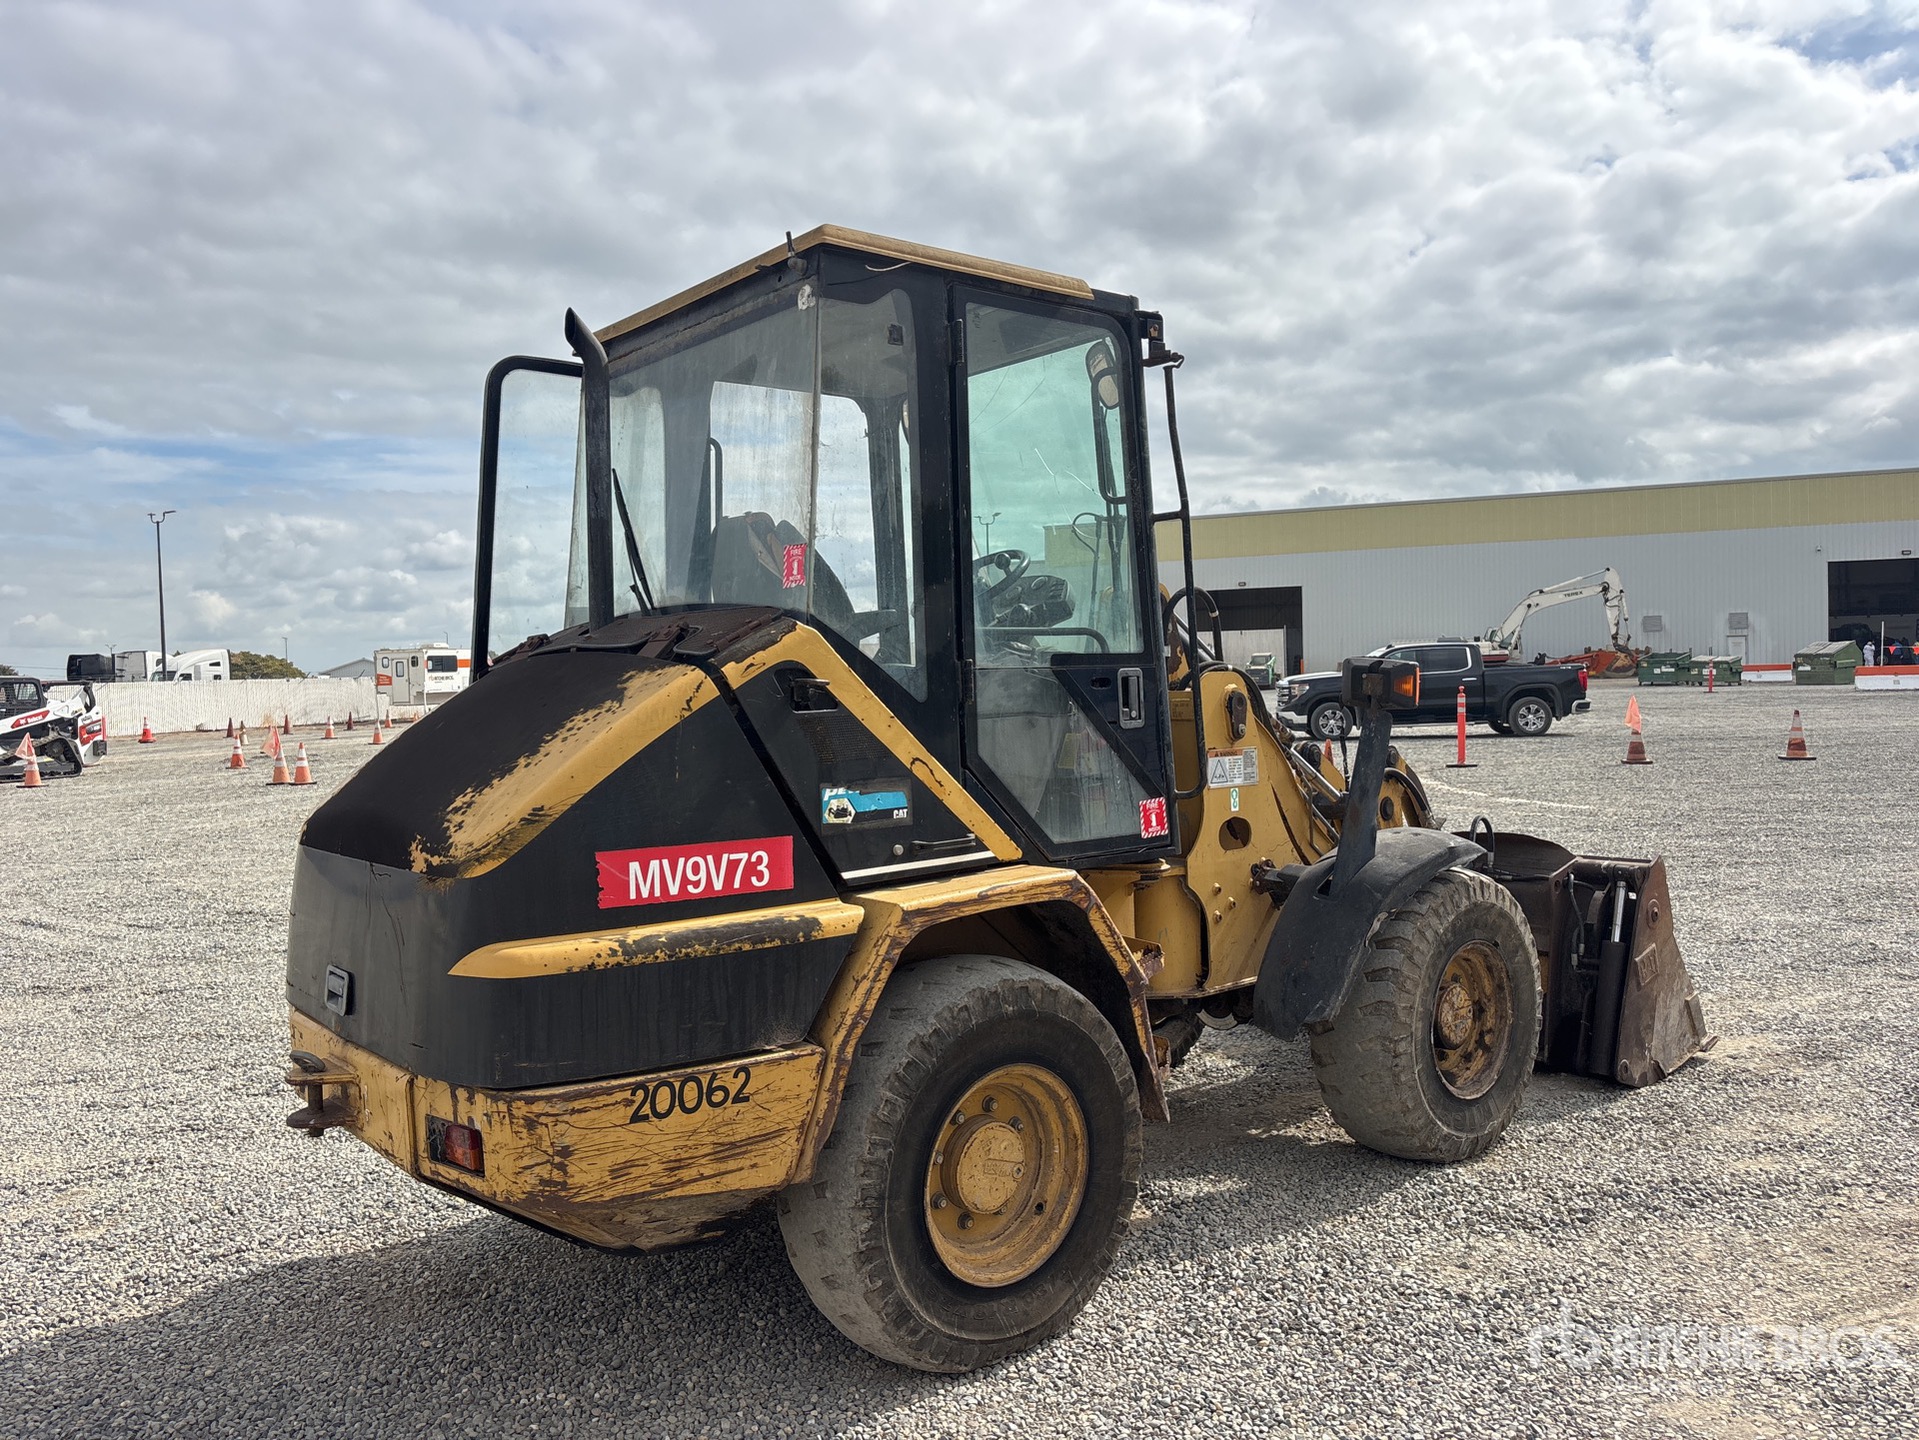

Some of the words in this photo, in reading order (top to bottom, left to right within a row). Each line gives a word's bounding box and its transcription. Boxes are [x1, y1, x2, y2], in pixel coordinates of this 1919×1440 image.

[893, 808, 908, 819] CAT
[628, 850, 771, 900] MV9V73
[629, 1066, 752, 1124] 20062
